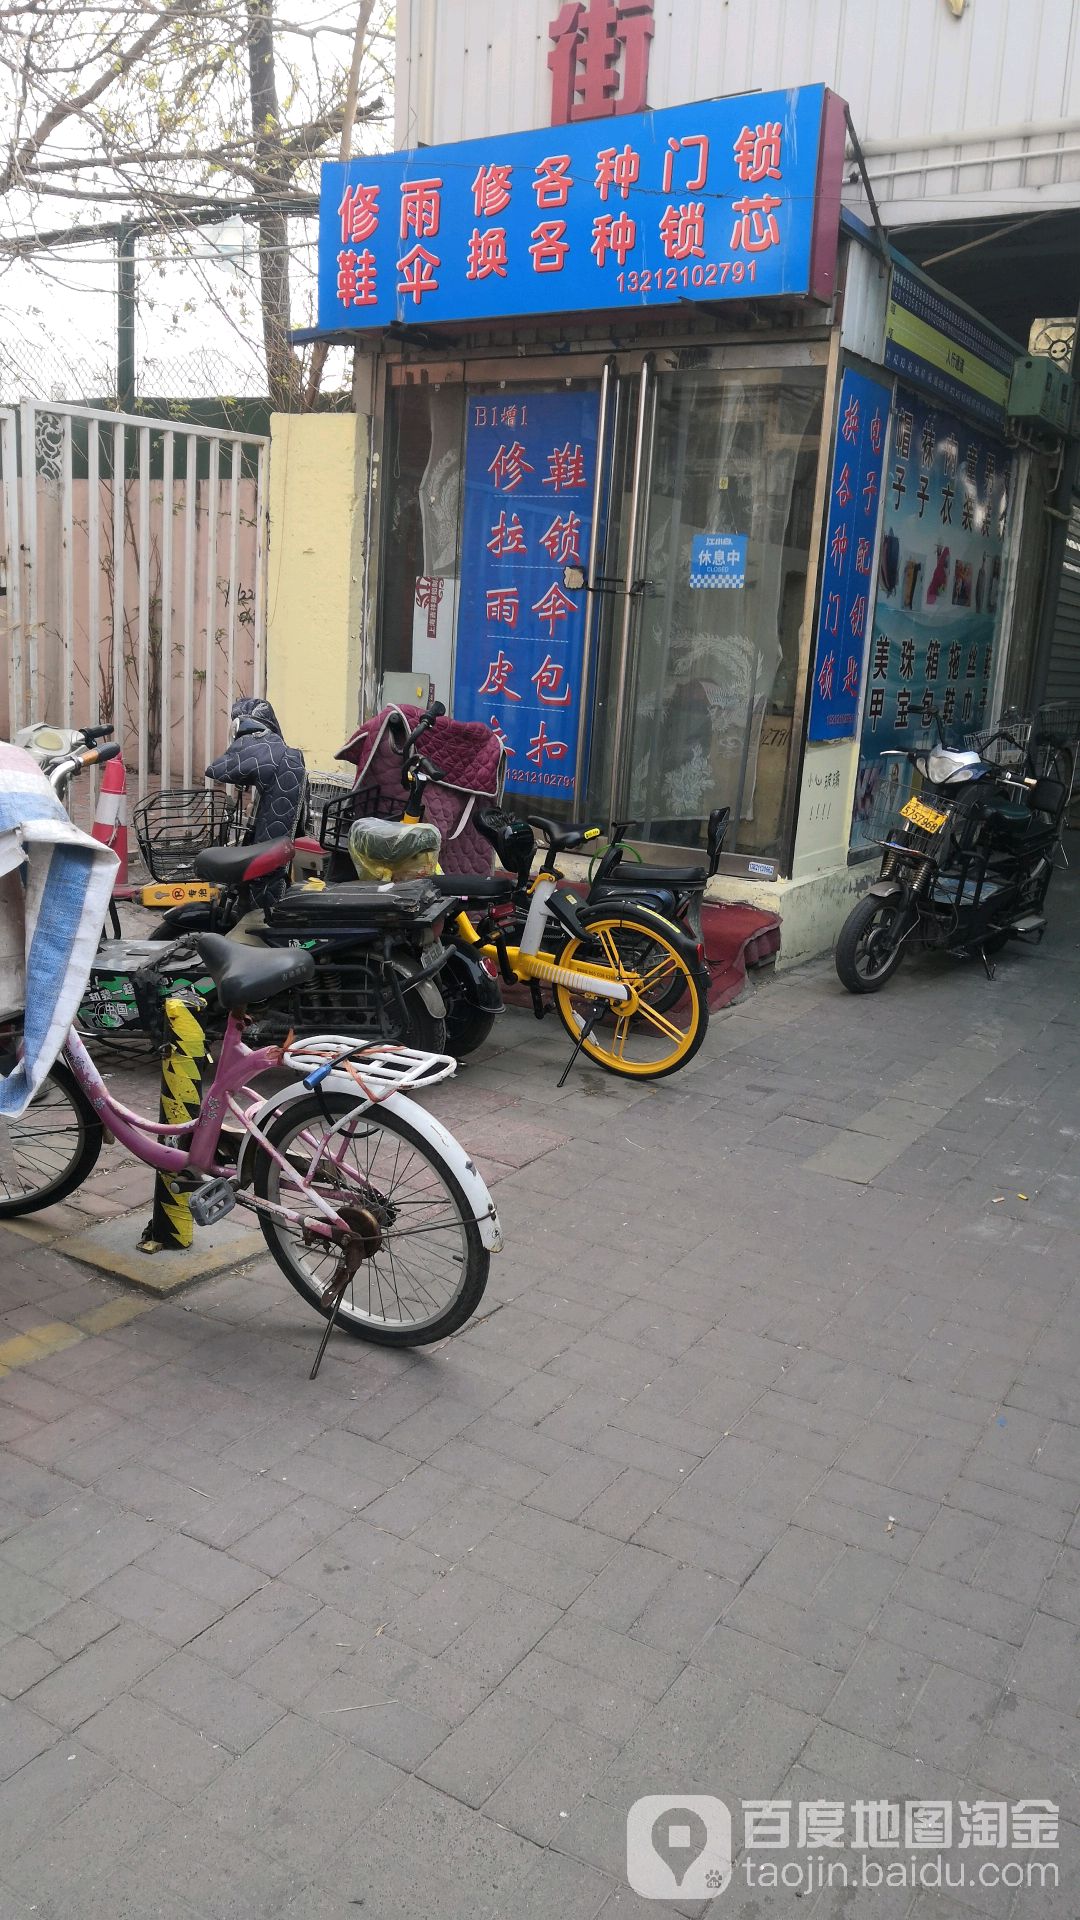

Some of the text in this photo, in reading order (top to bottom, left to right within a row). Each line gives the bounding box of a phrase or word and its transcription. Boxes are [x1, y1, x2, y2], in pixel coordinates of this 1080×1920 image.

[547, 0, 655, 127] 街
[616, 260, 757, 293] 13212102791
[488, 441, 587, 492] 修鞋
[487, 510, 581, 565] 拉锁
[698, 549, 740, 566] 休息中
[817, 394, 860, 700] 换各种门锁
[841, 407, 882, 698] 电子配钥匙
[486, 582, 578, 637] 雨伞
[478, 650, 571, 706] 皮包
[506, 768, 577, 789] 13212102791
